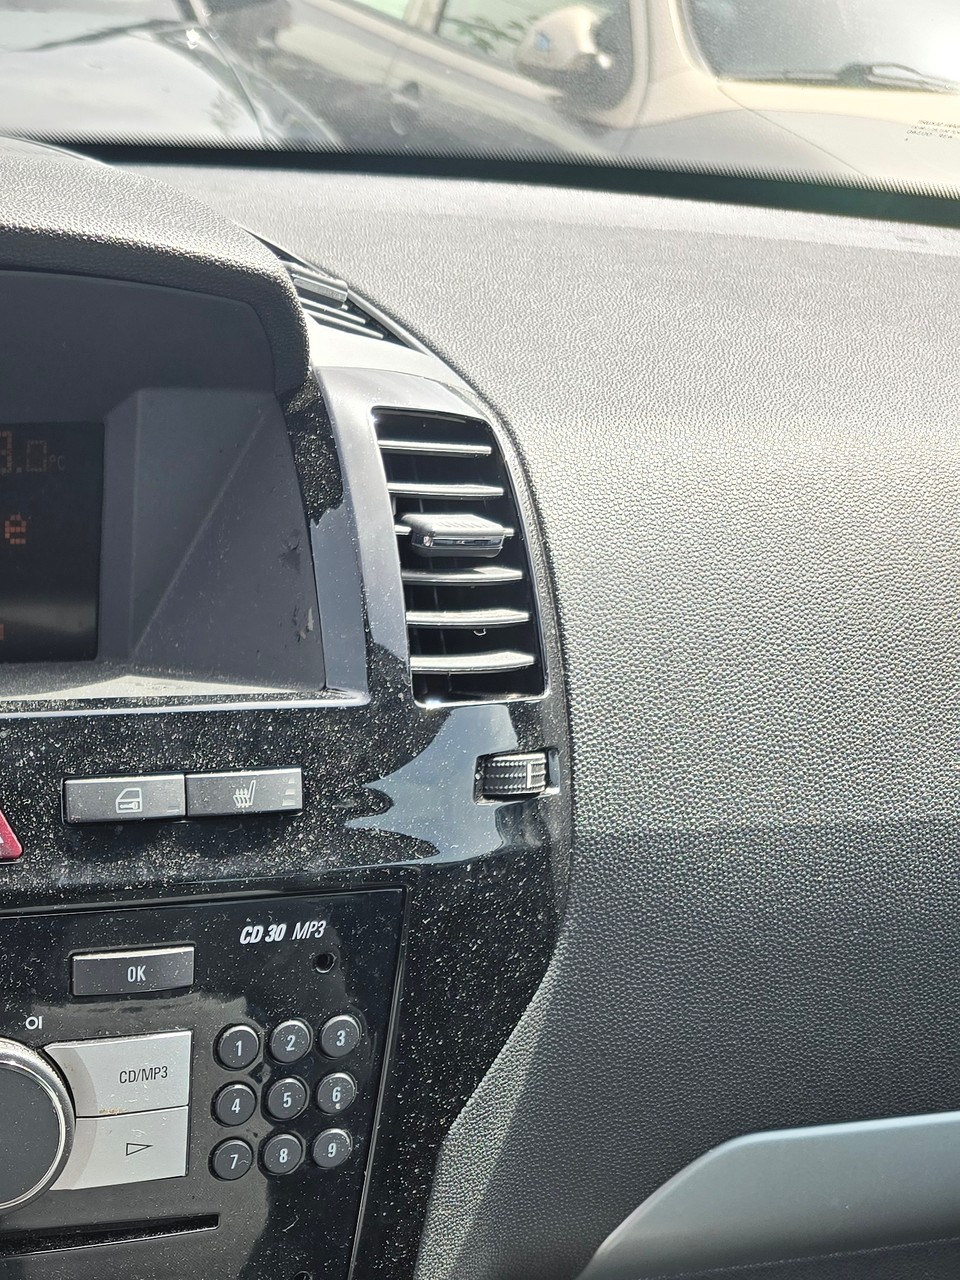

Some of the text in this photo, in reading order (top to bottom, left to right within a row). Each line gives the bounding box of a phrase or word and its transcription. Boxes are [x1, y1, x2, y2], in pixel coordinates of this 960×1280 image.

[239, 920, 327, 945] CD 30 MP3
[126, 965, 147, 984] OK
[286, 1034, 296, 1052] 2
[335, 1029, 346, 1047] 3
[236, 1040, 243, 1057] 1
[119, 1065, 168, 1084] CD/MP3
[282, 1091, 293, 1109] 5
[331, 1086, 341, 1102] 6
[230, 1097, 242, 1114] 4
[278, 1146, 289, 1164] 8
[327, 1141, 337, 1159] 9
[230, 1153, 239, 1170] 7
